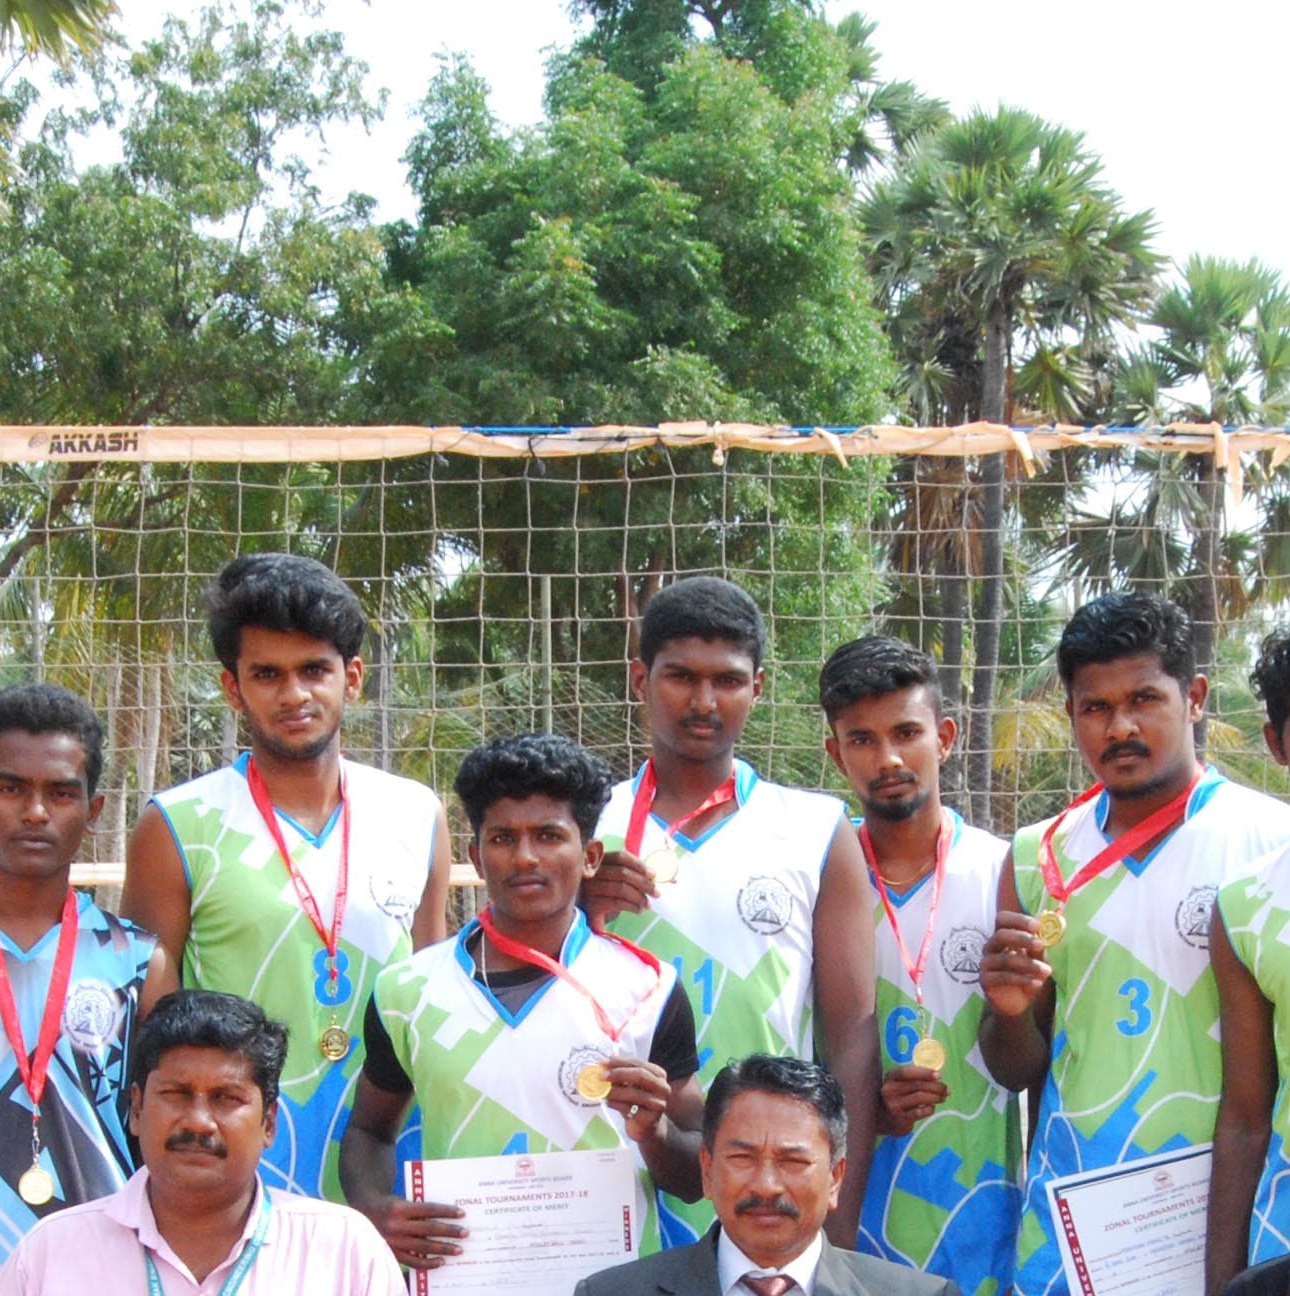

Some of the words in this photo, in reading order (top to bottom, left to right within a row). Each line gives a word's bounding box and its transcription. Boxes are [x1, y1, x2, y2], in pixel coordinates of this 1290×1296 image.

[49, 432, 138, 454] AKKASH
[313, 948, 352, 1007] 8
[1115, 977, 1153, 1037] 3
[884, 1005, 921, 1066] 6
[486, 1192, 552, 1204] TOURNAMENTS
[1104, 1218, 1131, 1232] ZONAL
[1133, 1198, 1195, 1223] TOURNAMENTS
[1060, 1205, 1076, 1238] ANNA
